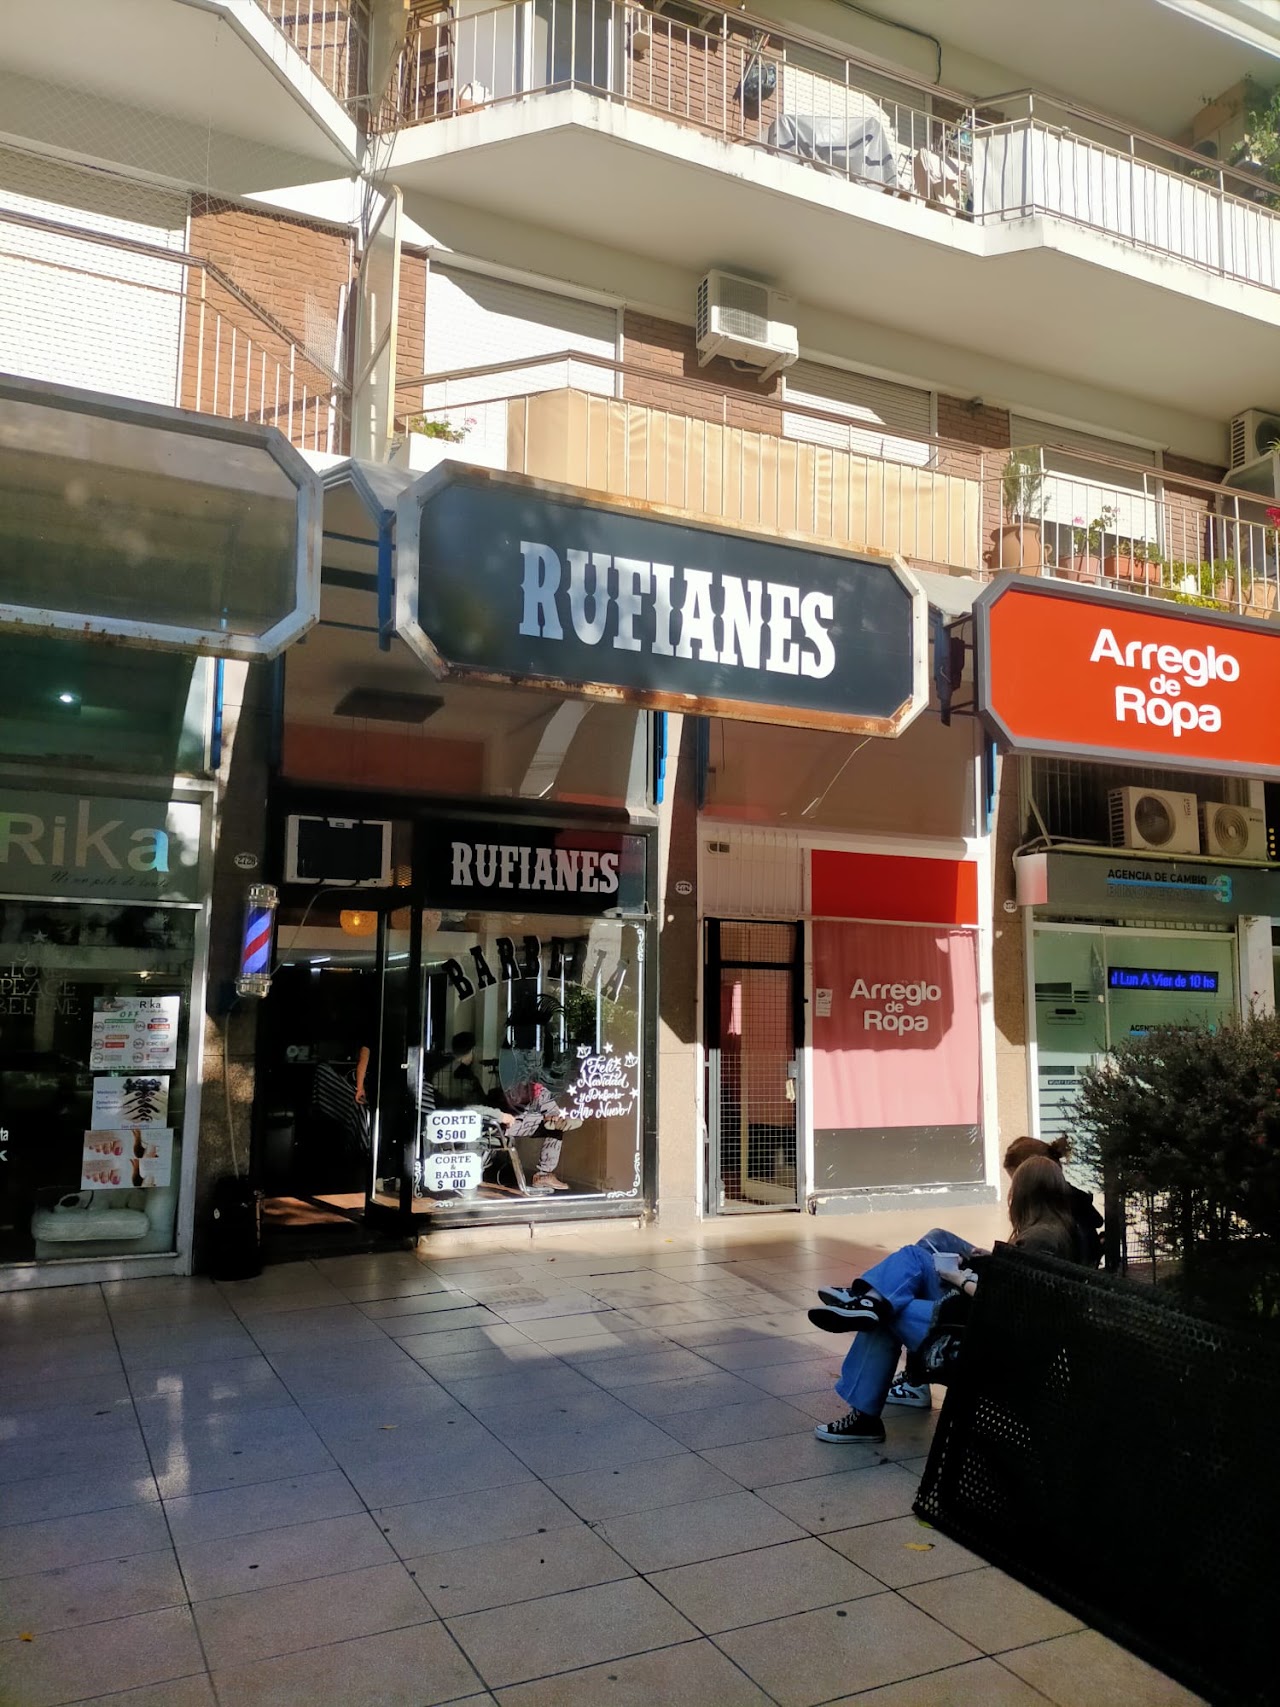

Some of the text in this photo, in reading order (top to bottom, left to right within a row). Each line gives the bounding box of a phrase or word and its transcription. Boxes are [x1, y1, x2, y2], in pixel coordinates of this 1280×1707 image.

[519, 541, 836, 679] RUFIANES
[1089, 628, 1240, 687] Arreglo
[1150, 673, 1181, 697] de
[1115, 685, 1222, 737] Ropa
[0, 799, 169, 872] Rika
[451, 841, 619, 894] RUFIANES
[1107, 869, 1208, 885] AGENCIA DE CAMBIO
[1120, 971, 1139, 985] Lun
[1140, 972, 1150, 986] A
[1174, 974, 1186, 988] de
[1190, 974, 1200, 988] 10
[1203, 975, 1215, 988] hs
[849, 978, 942, 1006] Arreglo
[140, 999, 161, 1009] Rka
[885, 1001, 904, 1013] de
[863, 1010, 929, 1036] Ropa
[432, 1115, 477, 1126] CORTE
[436, 1129, 467, 1141] $500
[435, 1155, 472, 1165] CORTE
[435, 1170, 472, 1179] BARBA
